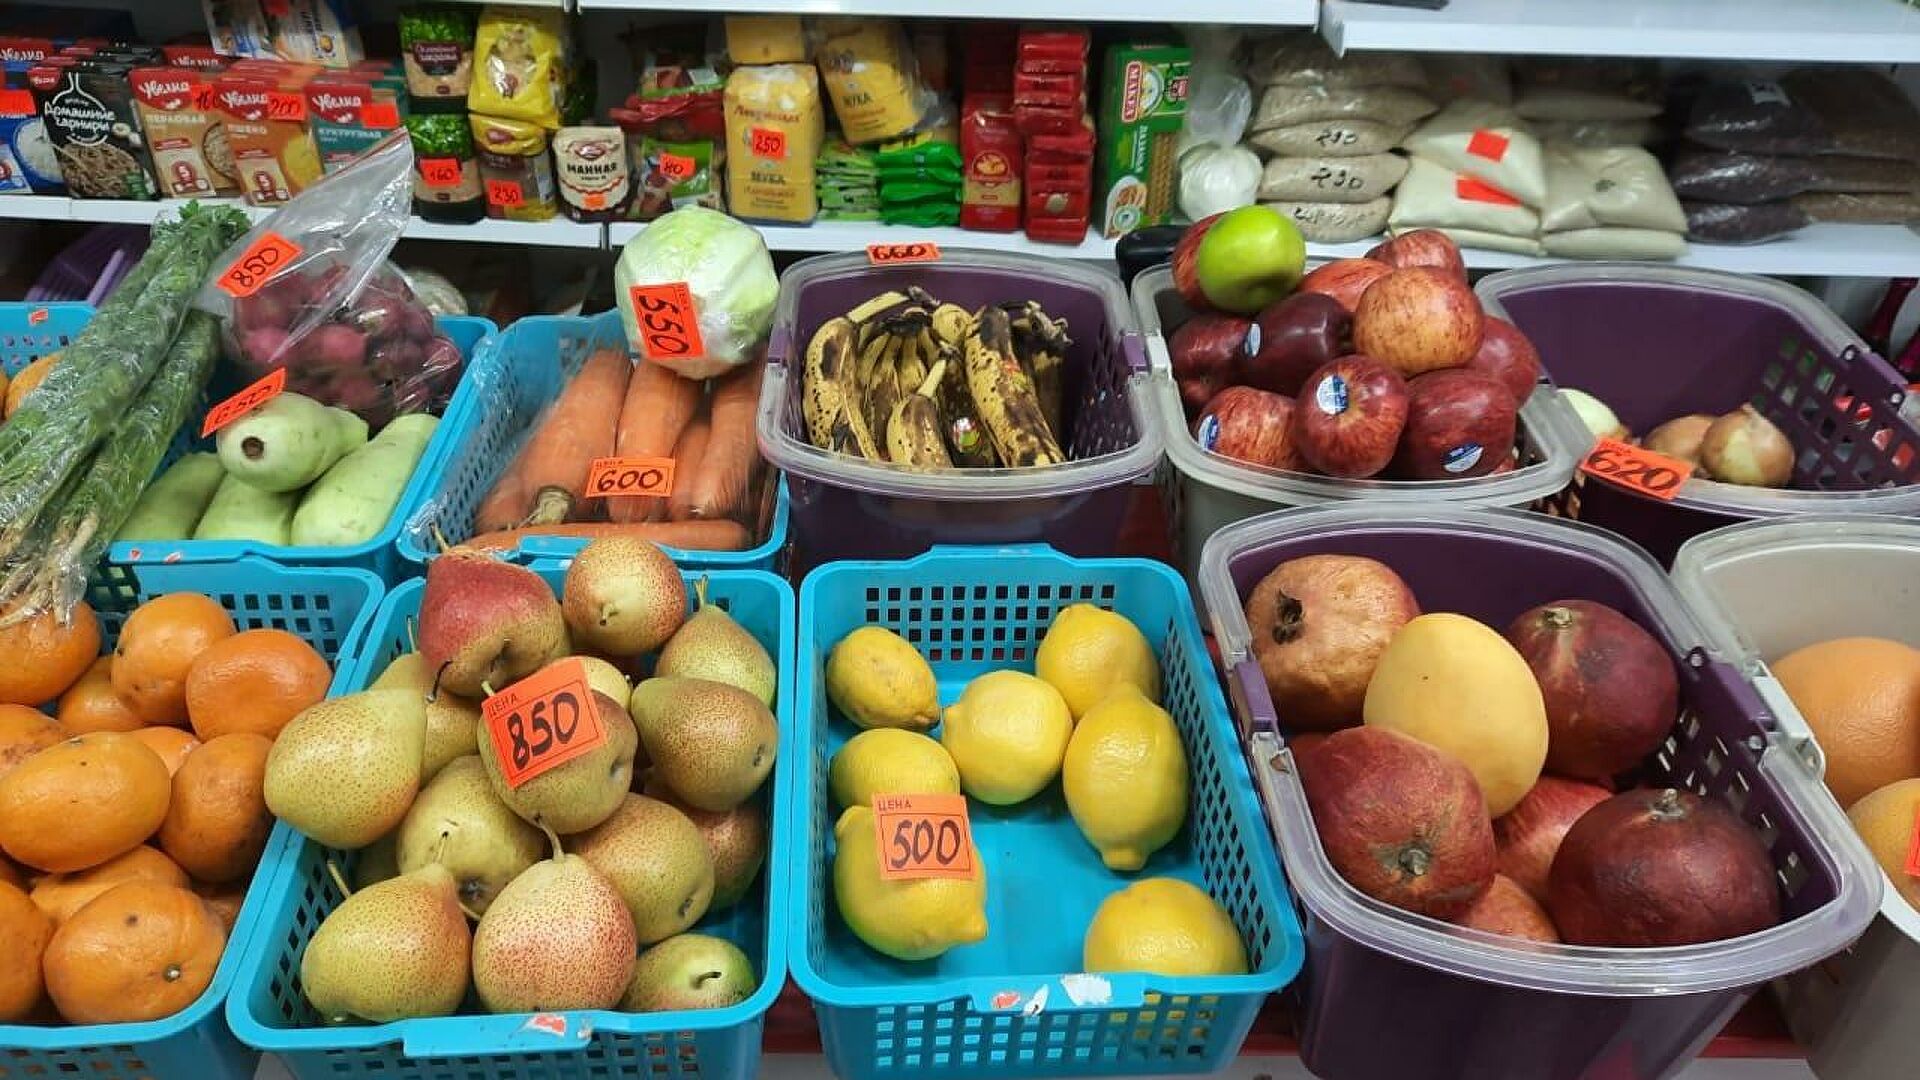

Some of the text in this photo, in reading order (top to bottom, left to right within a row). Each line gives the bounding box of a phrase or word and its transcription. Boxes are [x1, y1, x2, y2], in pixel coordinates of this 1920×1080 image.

[138, 80, 190, 99] Увелка
[221, 90, 269, 109] Увелка
[312, 93, 362, 112] Увелка
[755, 134, 781, 153] 250
[567, 162, 617, 175] МАННАЯ
[231, 247, 279, 287] 850
[638, 294, 690, 355] 550
[597, 469, 663, 492] 600
[1587, 449, 1681, 490] 620
[487, 693, 517, 718] ЦЕНА
[507, 692, 580, 770] 850
[878, 798, 912, 812] ЦЕНА
[890, 819, 961, 868] 500
